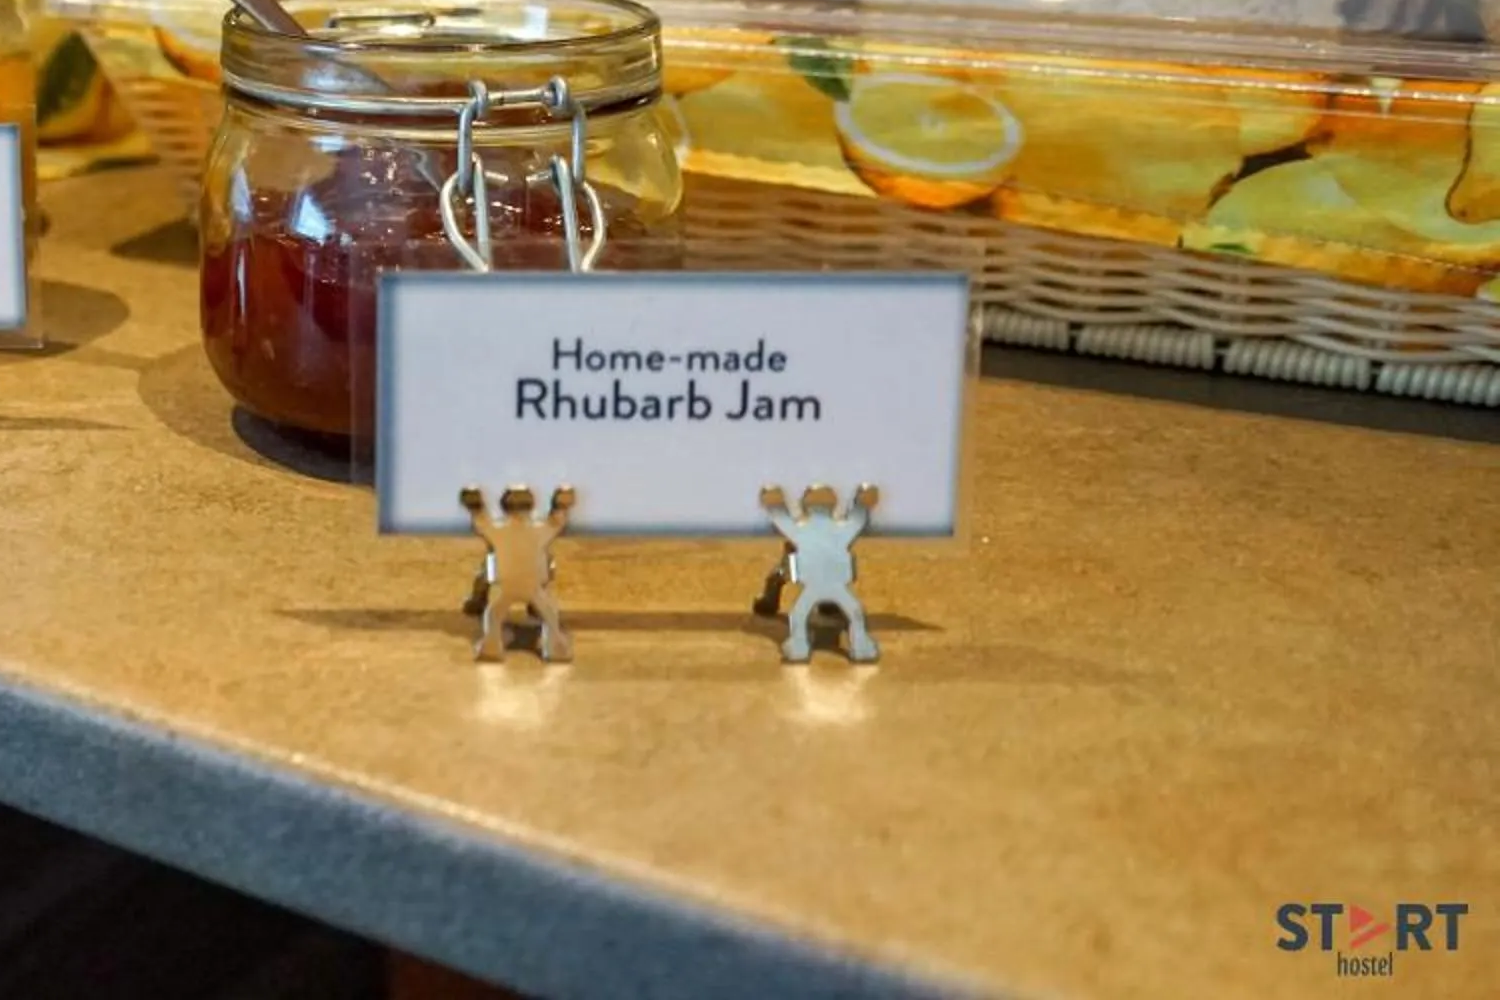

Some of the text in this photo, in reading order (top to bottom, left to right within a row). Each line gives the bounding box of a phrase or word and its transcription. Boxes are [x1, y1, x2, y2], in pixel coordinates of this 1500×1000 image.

[552, 338, 788, 373] Home-made
[515, 377, 822, 422] Rhubarb Jam
